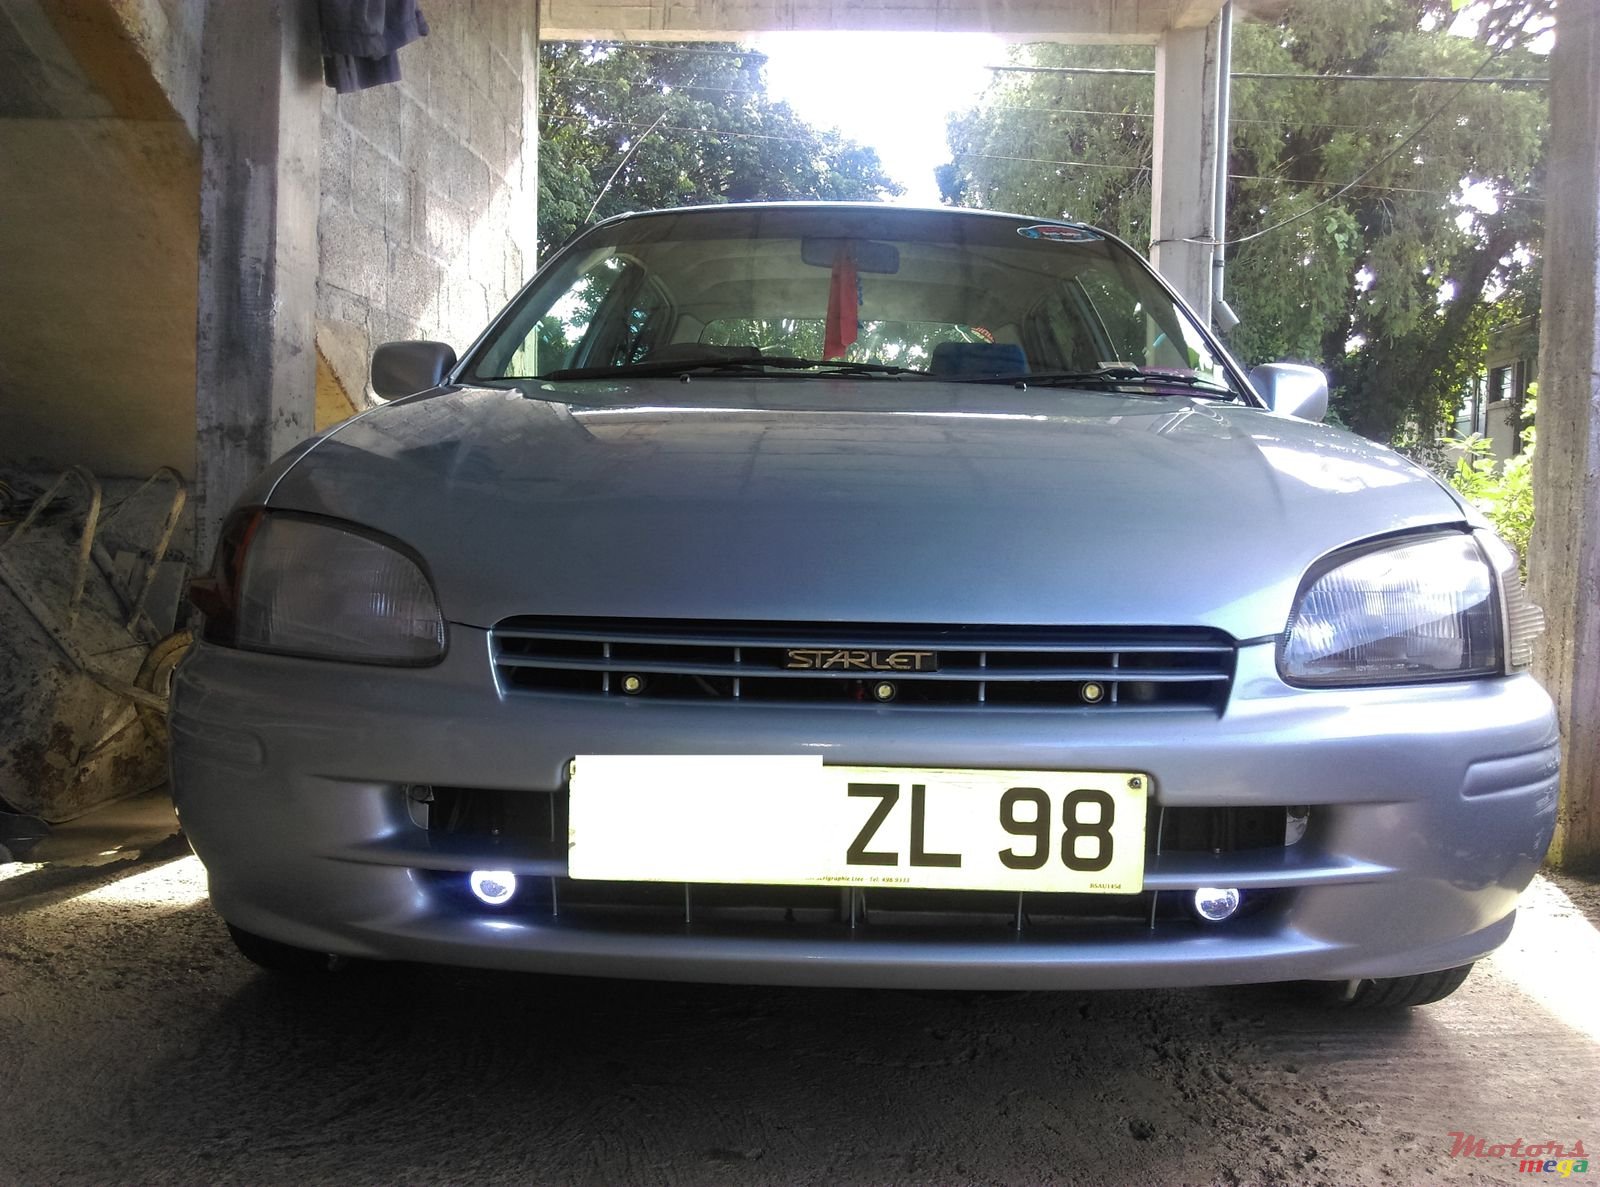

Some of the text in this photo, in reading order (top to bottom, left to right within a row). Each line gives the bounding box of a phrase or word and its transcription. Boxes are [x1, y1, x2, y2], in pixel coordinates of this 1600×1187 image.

[786, 649, 934, 670] STARLET
[846, 782, 1115, 872] ZL 98
